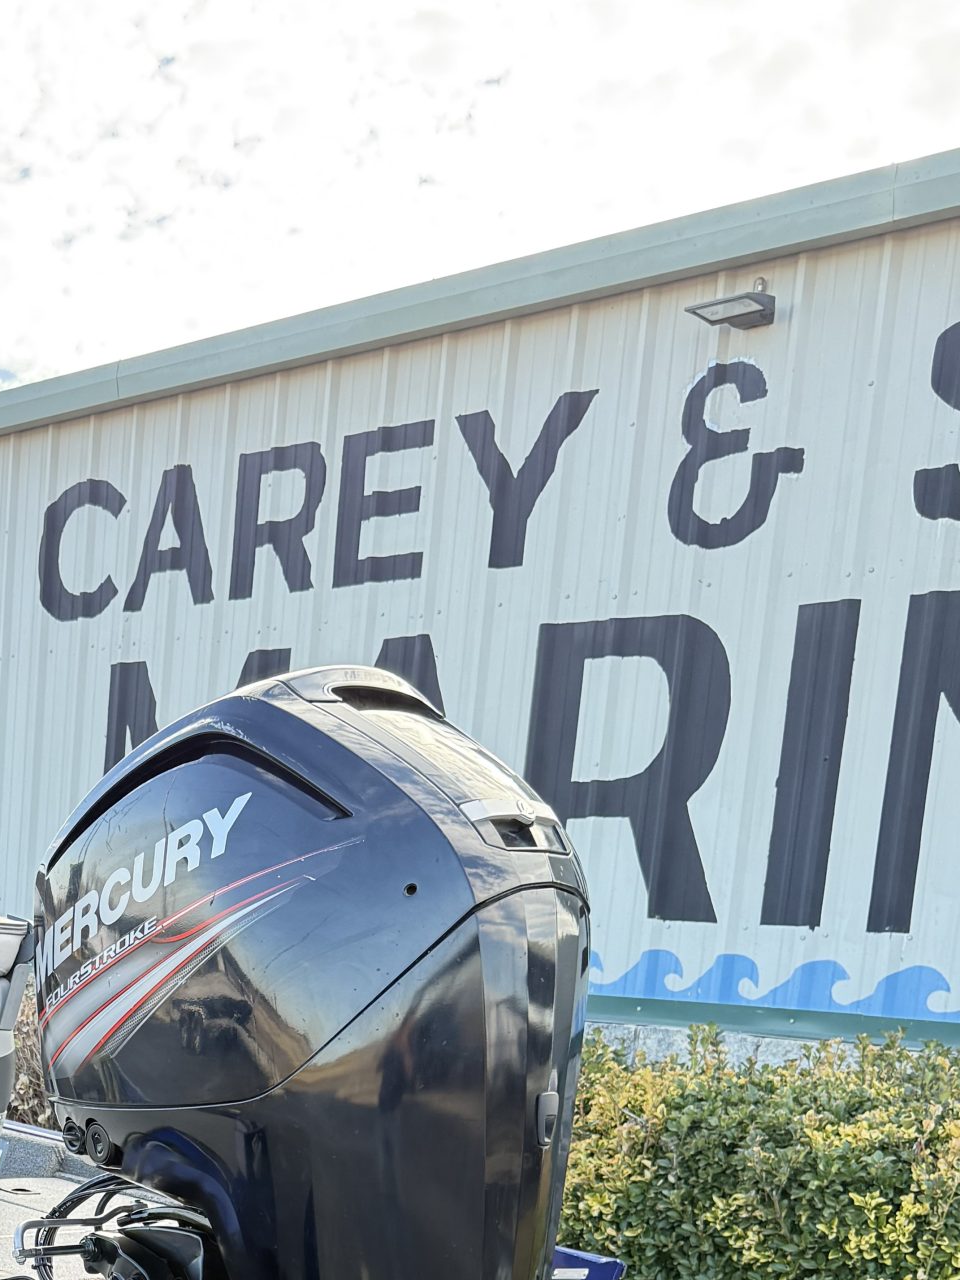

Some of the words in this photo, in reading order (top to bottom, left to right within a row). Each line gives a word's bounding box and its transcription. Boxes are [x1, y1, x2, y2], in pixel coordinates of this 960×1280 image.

[38, 389, 599, 622] CAREY
[668, 358, 804, 549] &
[35, 792, 253, 994] MERCURY
[45, 915, 161, 1014] FOURSTROKE
